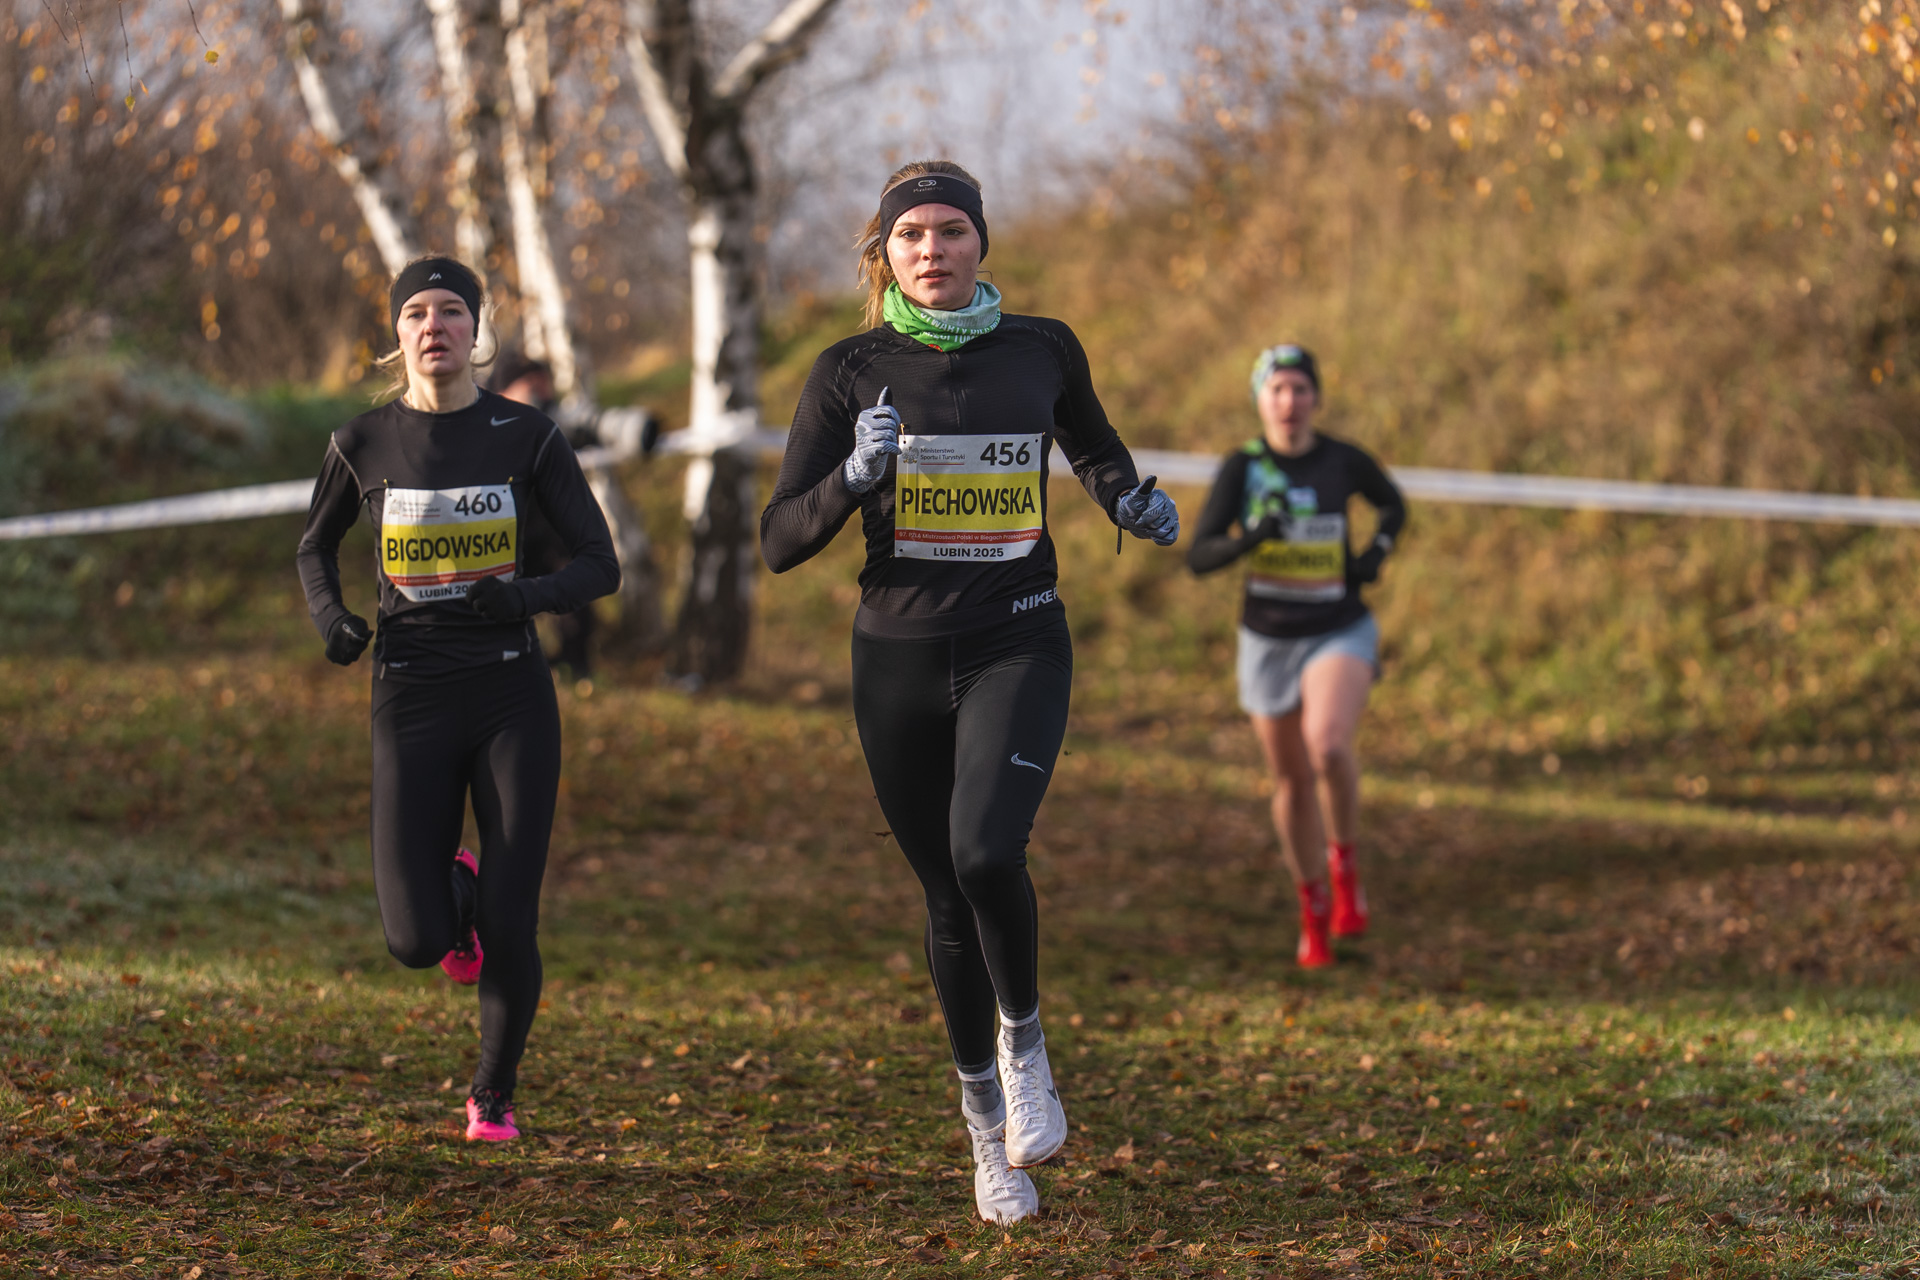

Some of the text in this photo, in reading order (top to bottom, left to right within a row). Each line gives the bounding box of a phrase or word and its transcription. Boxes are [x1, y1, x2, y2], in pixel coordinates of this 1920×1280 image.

[980, 442, 1031, 467] 456
[454, 492, 502, 516] 460
[901, 486, 1036, 516] PIECHOWSKA
[386, 531, 511, 562] BIGDOWSKA
[922, 533, 956, 541] Mistrzostwa
[980, 534, 1003, 542] Biegach
[933, 547, 1004, 558] LUBIN 2025
[419, 584, 471, 599] LUBIN 20
[1012, 589, 1053, 614] NIKE
